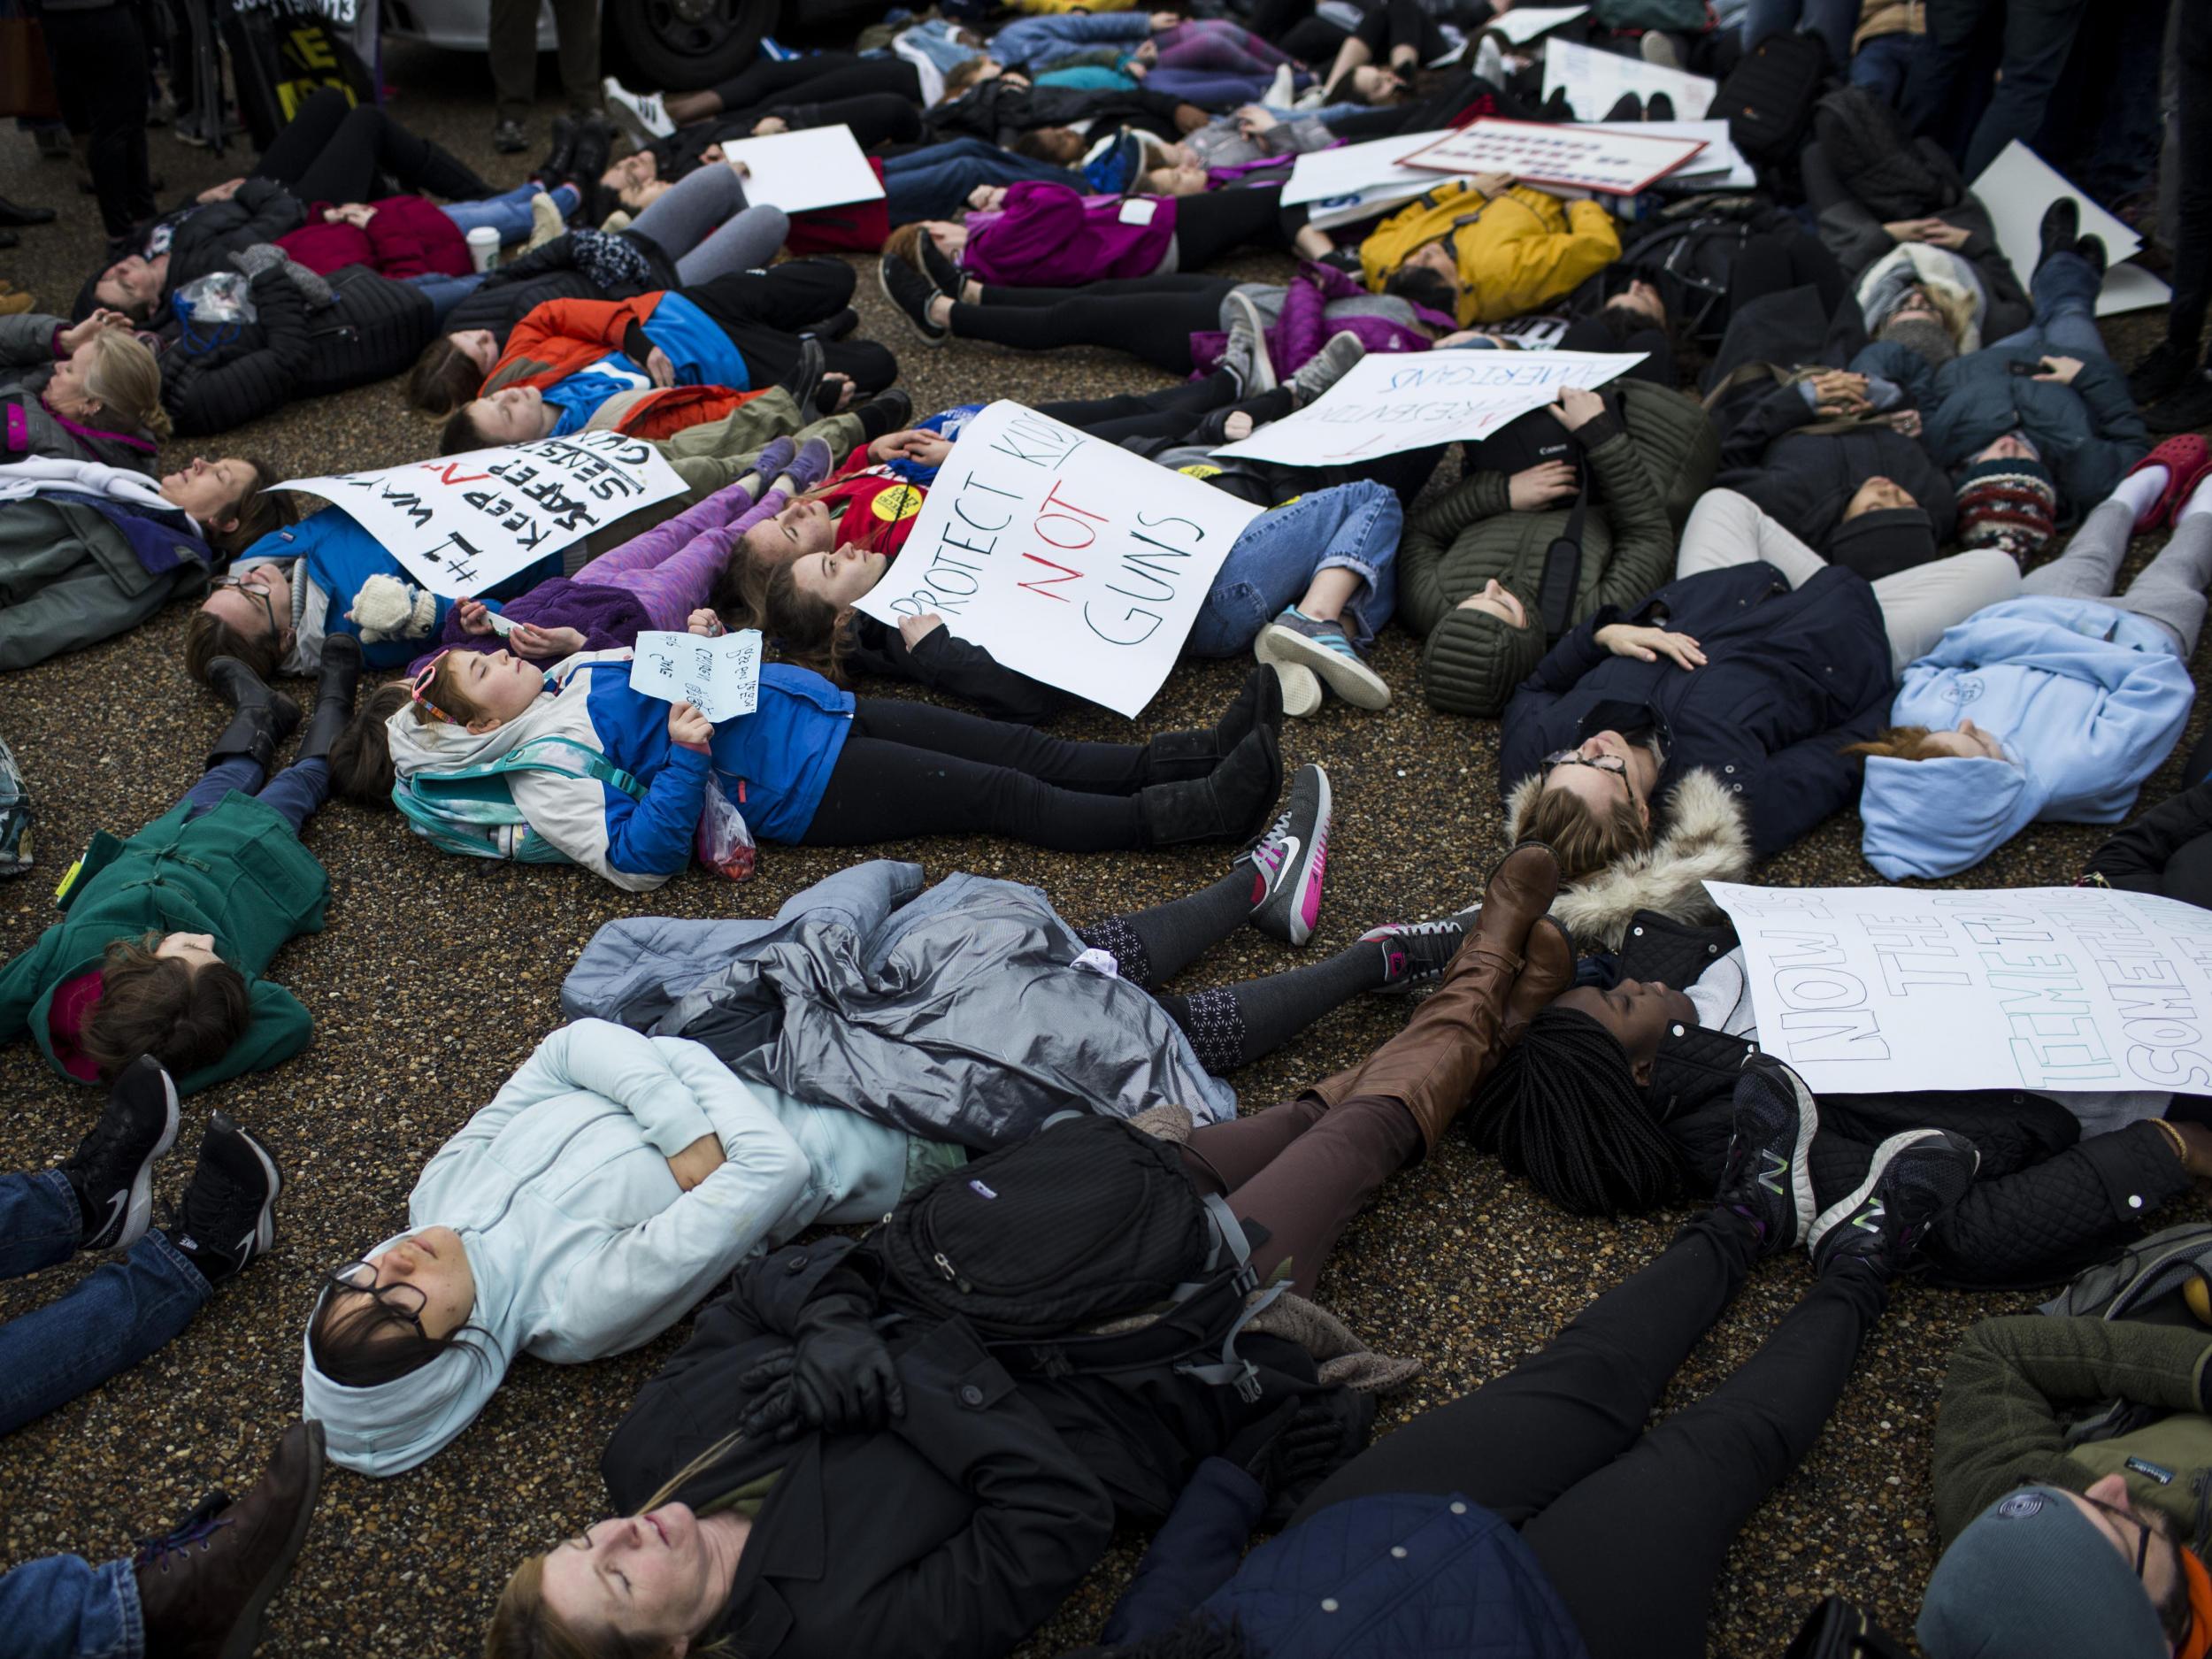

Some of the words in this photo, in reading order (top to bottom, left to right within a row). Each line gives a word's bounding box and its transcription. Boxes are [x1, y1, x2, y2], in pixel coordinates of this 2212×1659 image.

[1539, 443, 1568, 456] Canon
[349, 476, 434, 529] WAY
[462, 490, 552, 550] KEEP
[488, 459, 601, 532] SAFE?
[420, 531, 485, 583] #1
[890, 471, 1024, 616] PROTECT
[1018, 480, 1110, 603] NOT
[1085, 511, 1205, 646] GUNS
[1855, 913, 1973, 996] THE
[1952, 911, 2055, 945] TO
[1760, 930, 1890, 1064] NOW
[1978, 953, 2121, 1088] TIME
[2014, 890, 2212, 1088] SOMETHING
